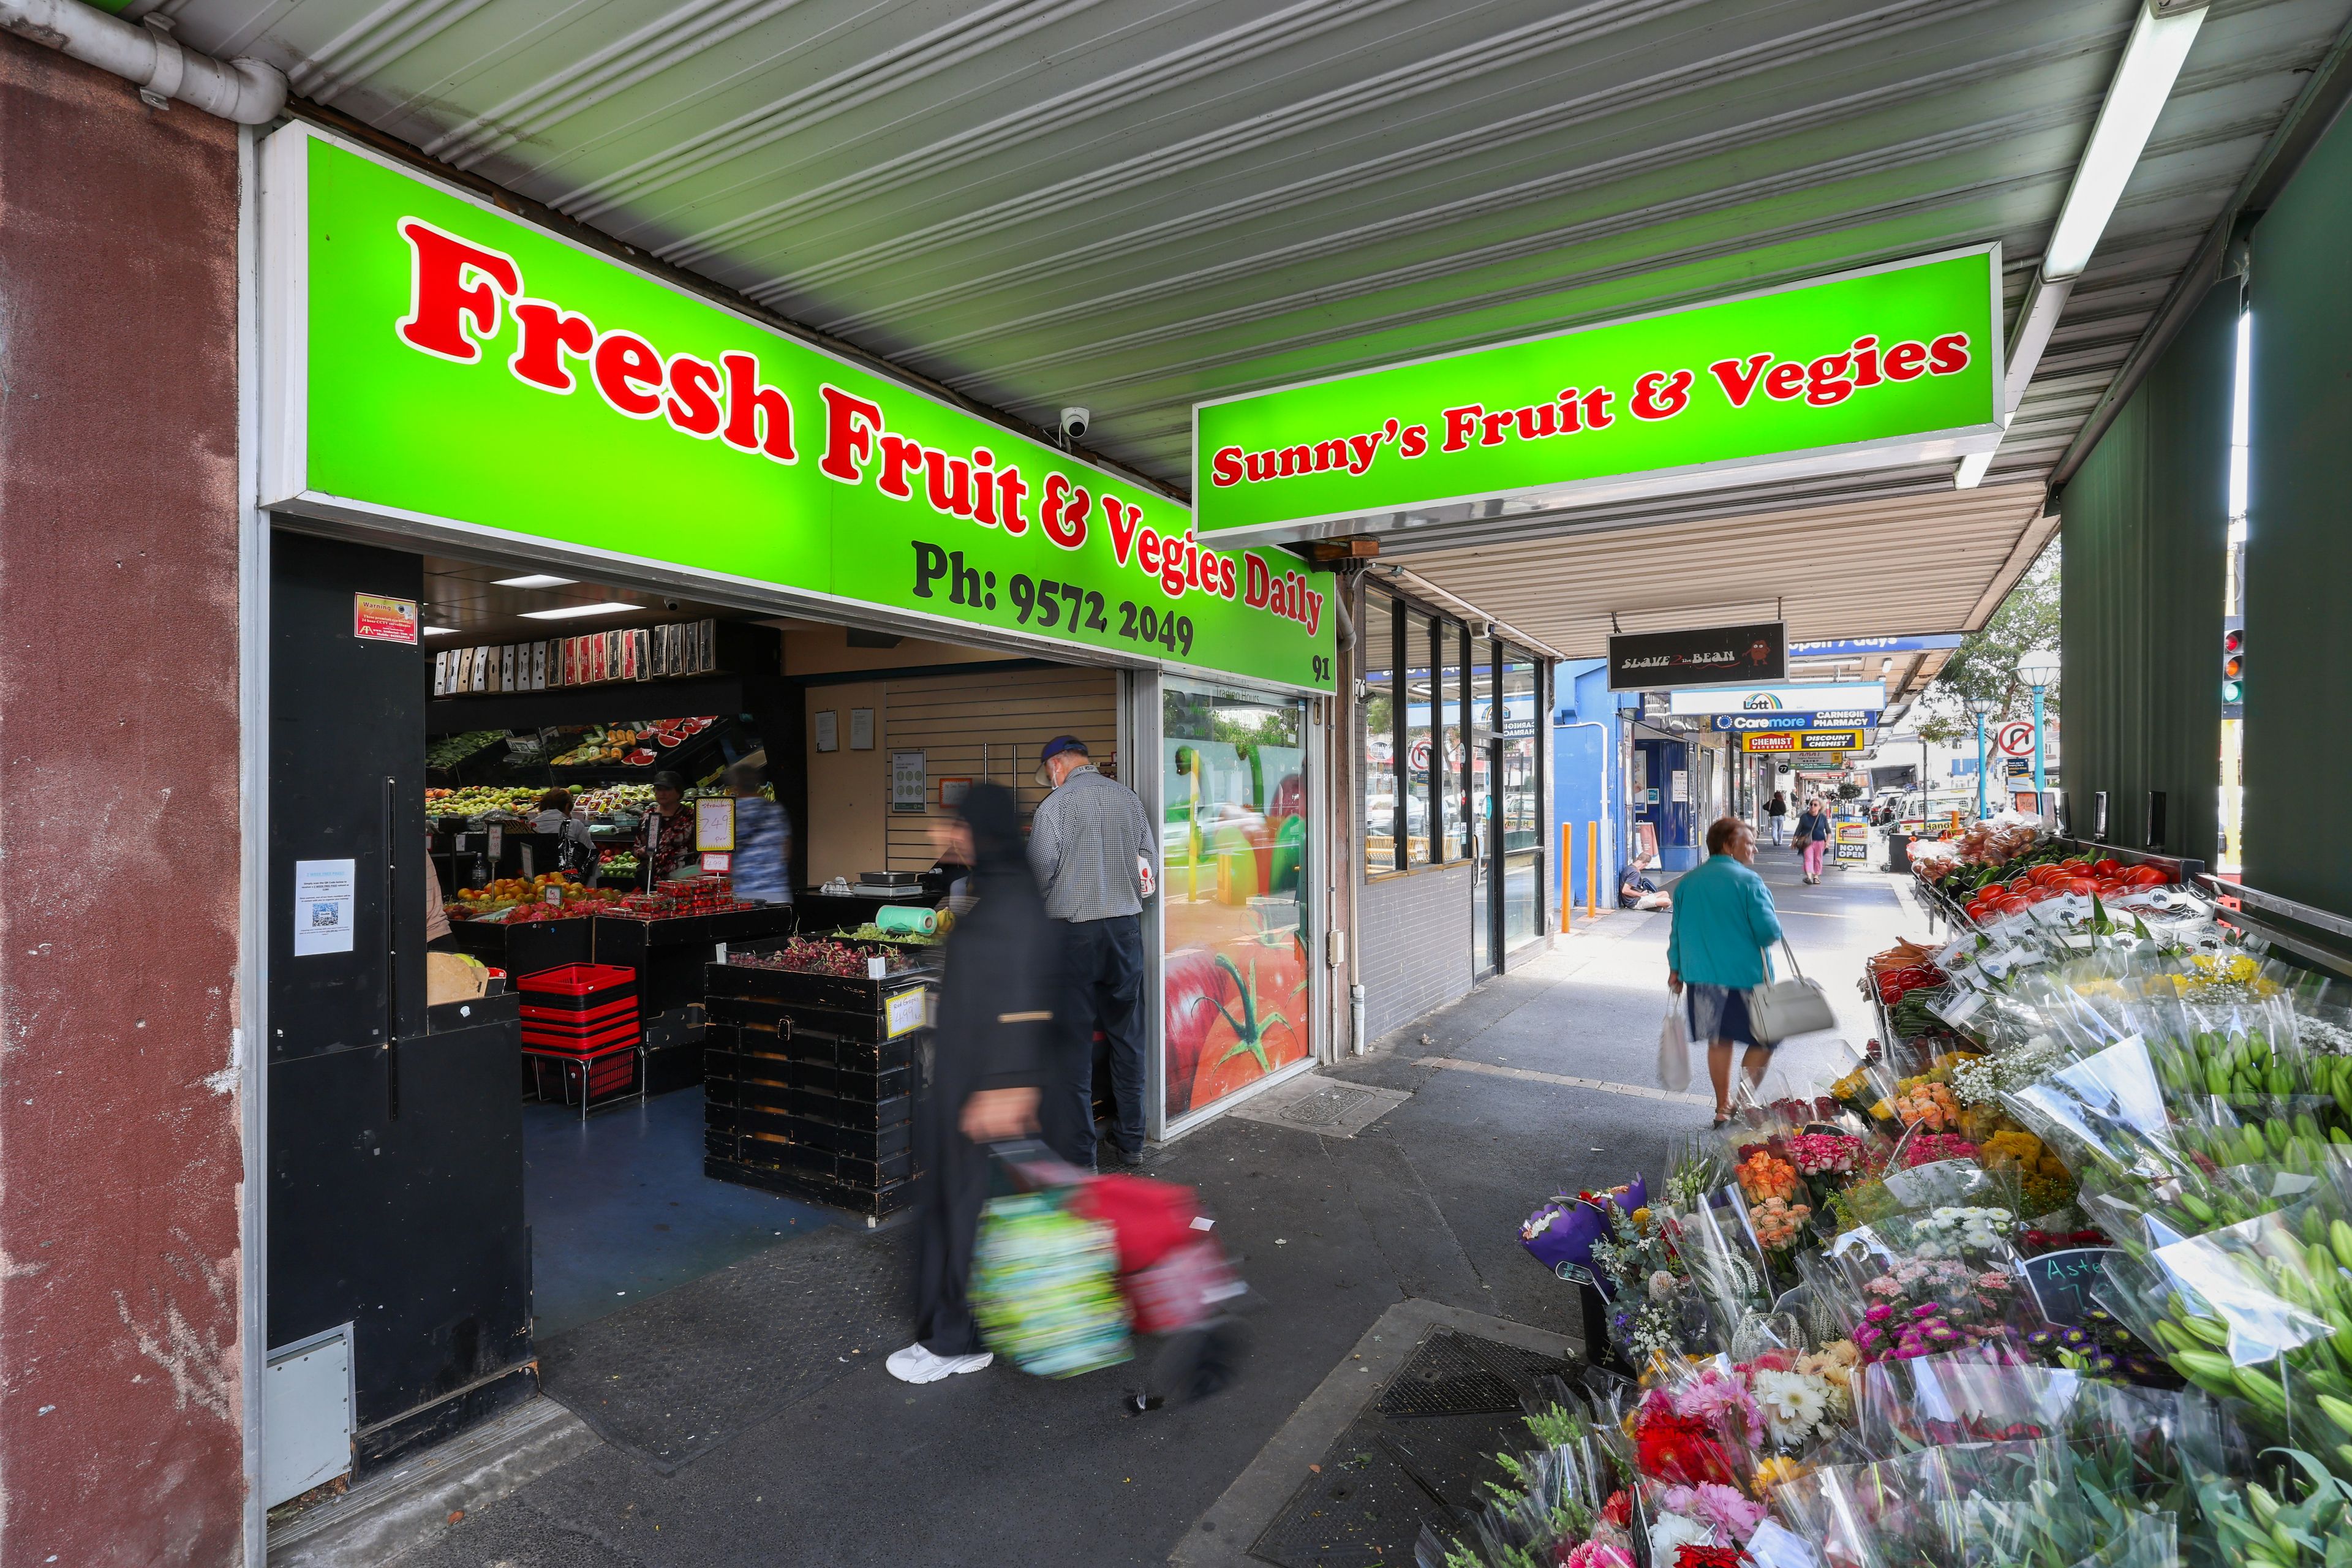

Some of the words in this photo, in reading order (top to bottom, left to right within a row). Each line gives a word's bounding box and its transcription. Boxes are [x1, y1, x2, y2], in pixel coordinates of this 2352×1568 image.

[1212, 418, 1427, 487] Sunny's
[1442, 388, 1613, 452] Fruit
[1630, 371, 1692, 420] &
[1709, 334, 1968, 407] Vegies
[401, 221, 796, 461] Fresh
[820, 386, 1027, 535] Fruit
[1040, 473, 1090, 549] &
[1102, 496, 1236, 599] Vegies
[1245, 554, 1323, 636] Daily
[363, 601, 391, 612] Warning
[911, 540, 996, 611] Ph:
[1009, 573, 1107, 633] 9572
[1118, 601, 1193, 657] 2049
[1692, 650, 1735, 664] BEAN
[1312, 655, 1330, 682] 91
[1215, 685, 1240, 703] Trading
[1242, 690, 1260, 703] Hours
[1743, 700, 1769, 710] Lott
[1734, 717, 1805, 728] Caremore
[1814, 718, 1868, 727] PHARMACY
[1751, 737, 1792, 745] CHEMIST
[699, 815, 728, 835] 2.49
[2048, 1259, 2105, 1280] Aste
